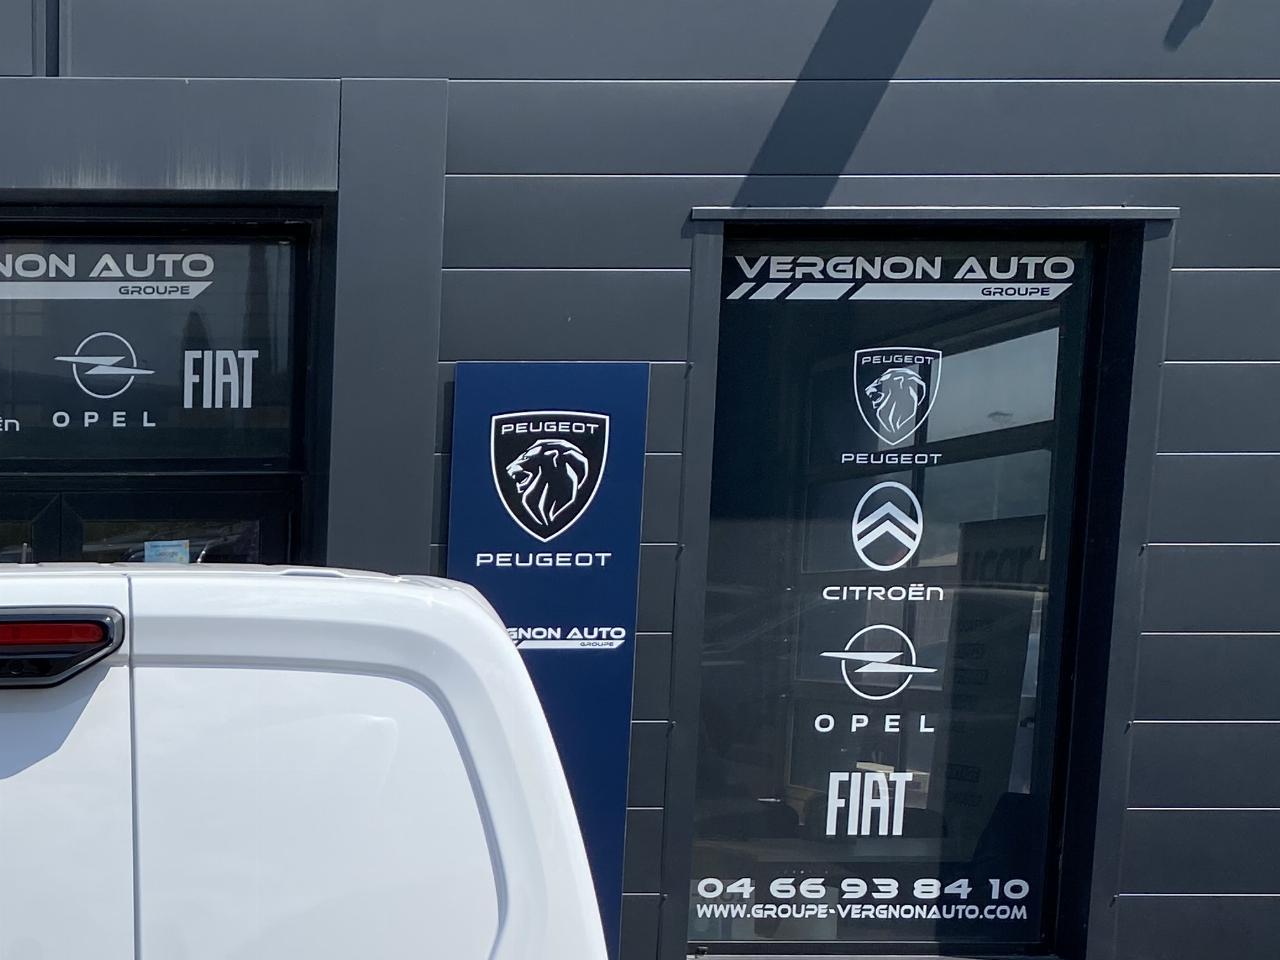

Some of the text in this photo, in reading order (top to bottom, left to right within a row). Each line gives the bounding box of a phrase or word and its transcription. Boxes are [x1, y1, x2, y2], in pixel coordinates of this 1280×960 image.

[88, 253, 216, 278] AUTO
[733, 255, 1076, 280] VERGNON AUTO
[118, 284, 191, 296] GROUPE
[980, 286, 1051, 297] GROUPE
[861, 355, 936, 365] PEUGEOT
[183, 349, 260, 409] FIAT
[52, 411, 157, 428] OPEL
[501, 421, 600, 436] PEUGEOT
[841, 453, 943, 465] PEUGEOT
[476, 552, 612, 567] PEUGEOT
[822, 583, 945, 602] CITROËN
[506, 627, 626, 639] GNON AUTO
[814, 714, 935, 733] OPEL
[825, 772, 914, 836] FIAT
[697, 877, 1030, 899] 04 66 93 84 10
[696, 904, 1028, 920] WWW.GROUPE-VERGNONAUTO.COM
